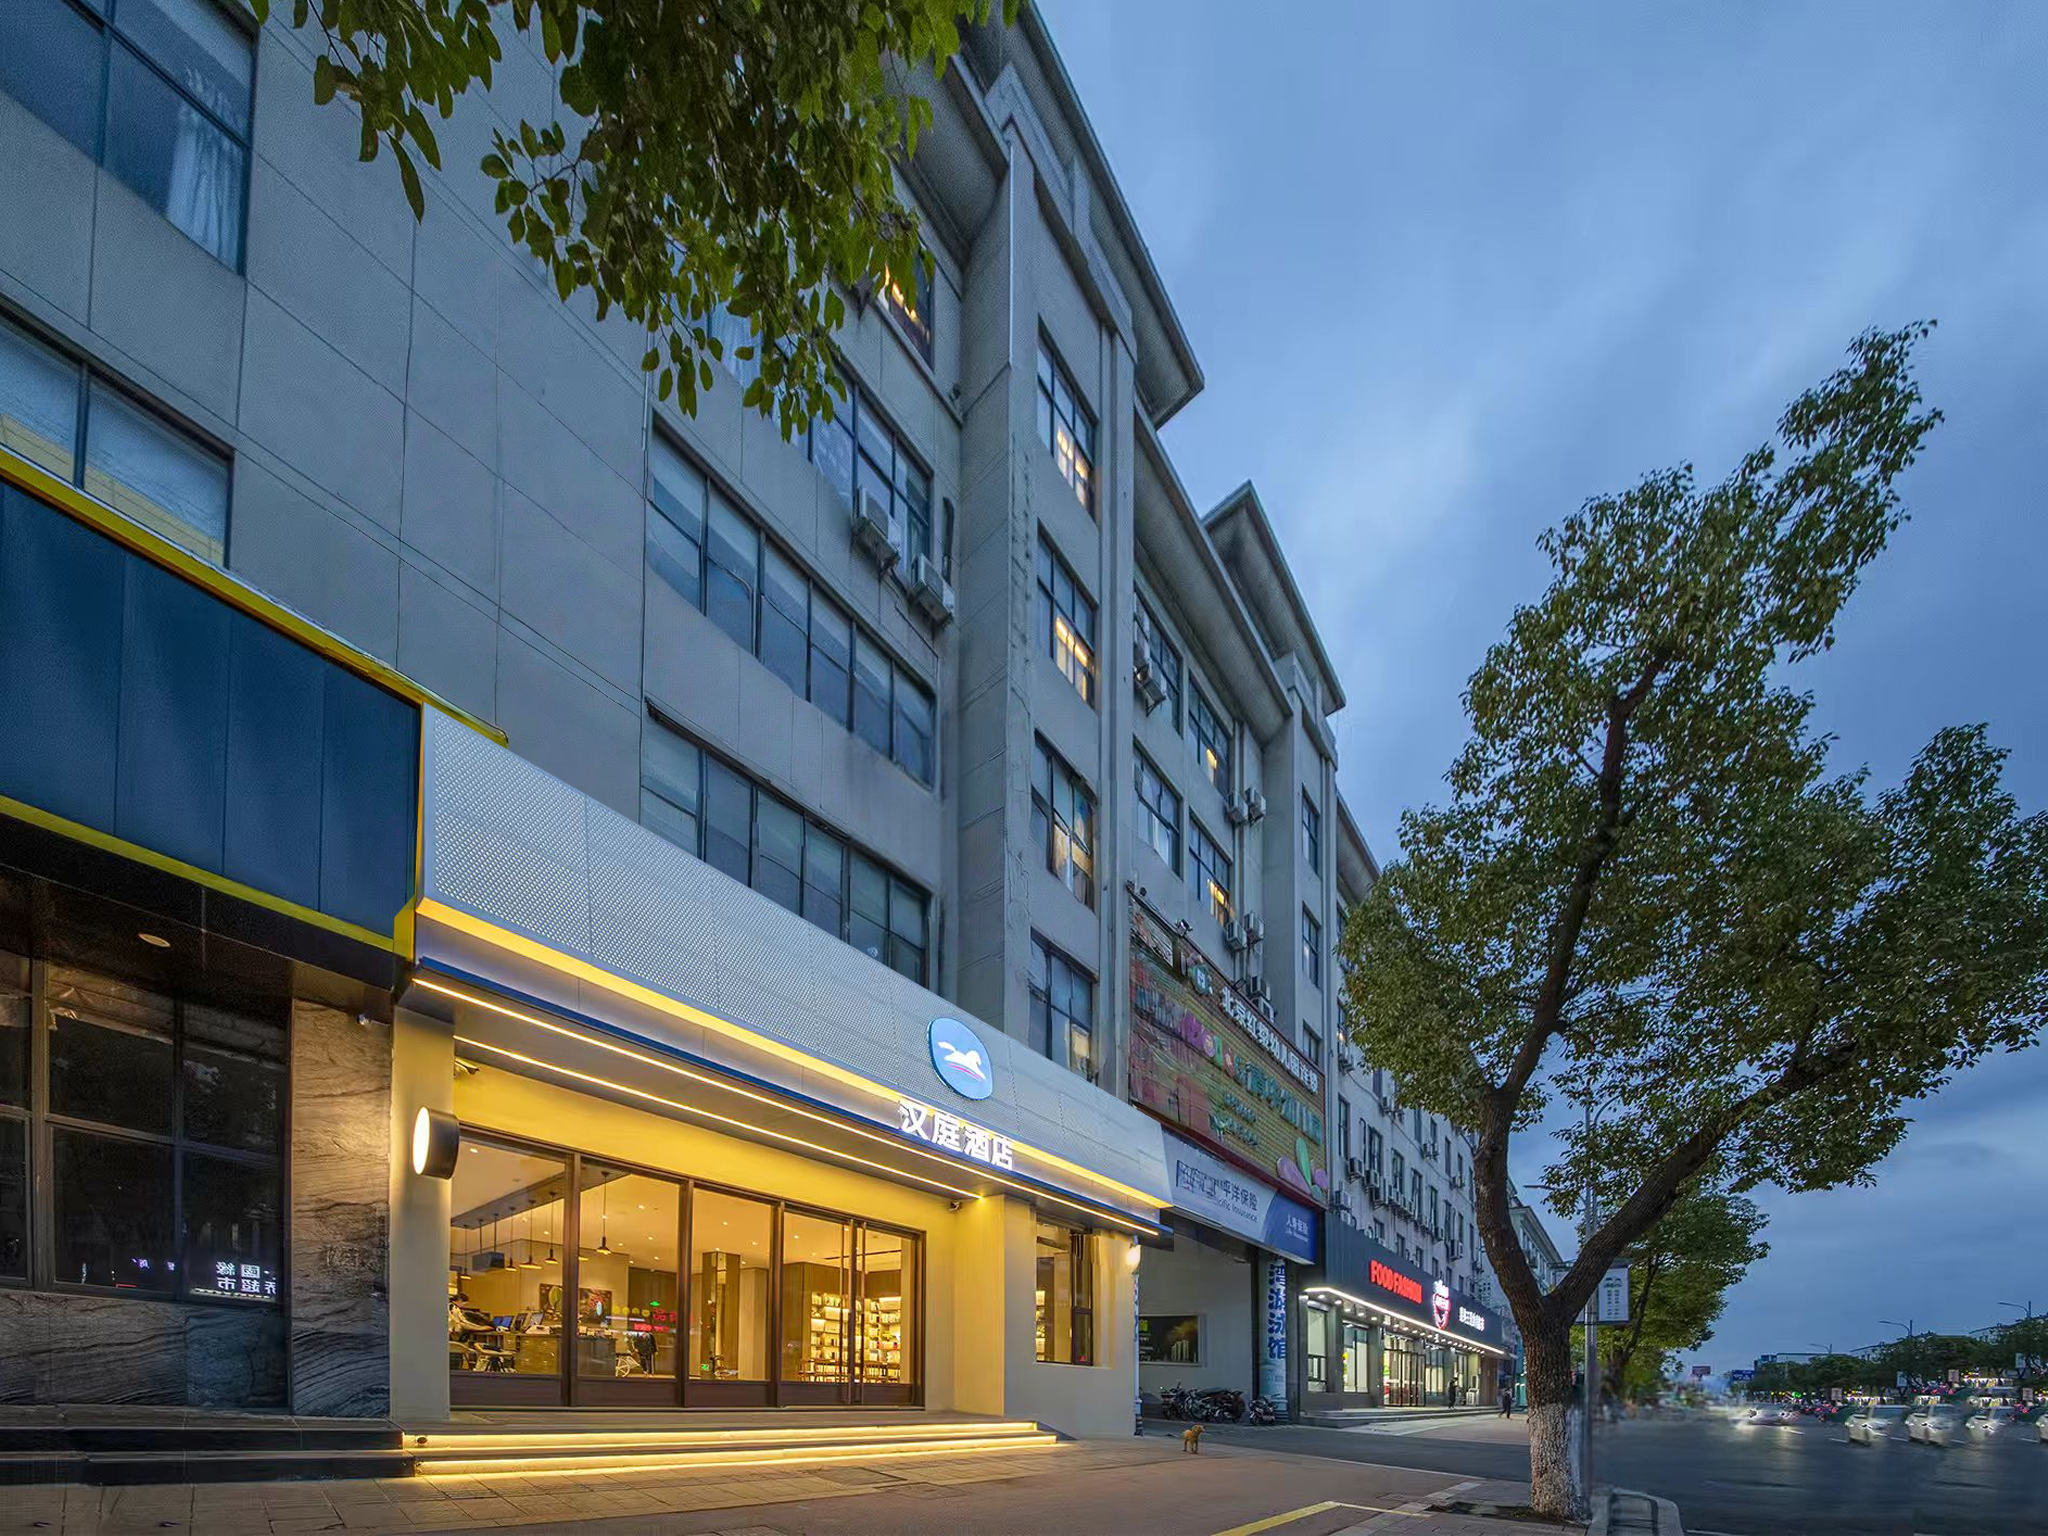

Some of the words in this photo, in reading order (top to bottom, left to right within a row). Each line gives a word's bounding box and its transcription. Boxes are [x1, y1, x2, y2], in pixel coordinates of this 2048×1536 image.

[898, 1100, 1013, 1170] 汉庭酒店
[1371, 1259, 1394, 1291] FOOD
[1393, 1271, 1422, 1304] FASHION
